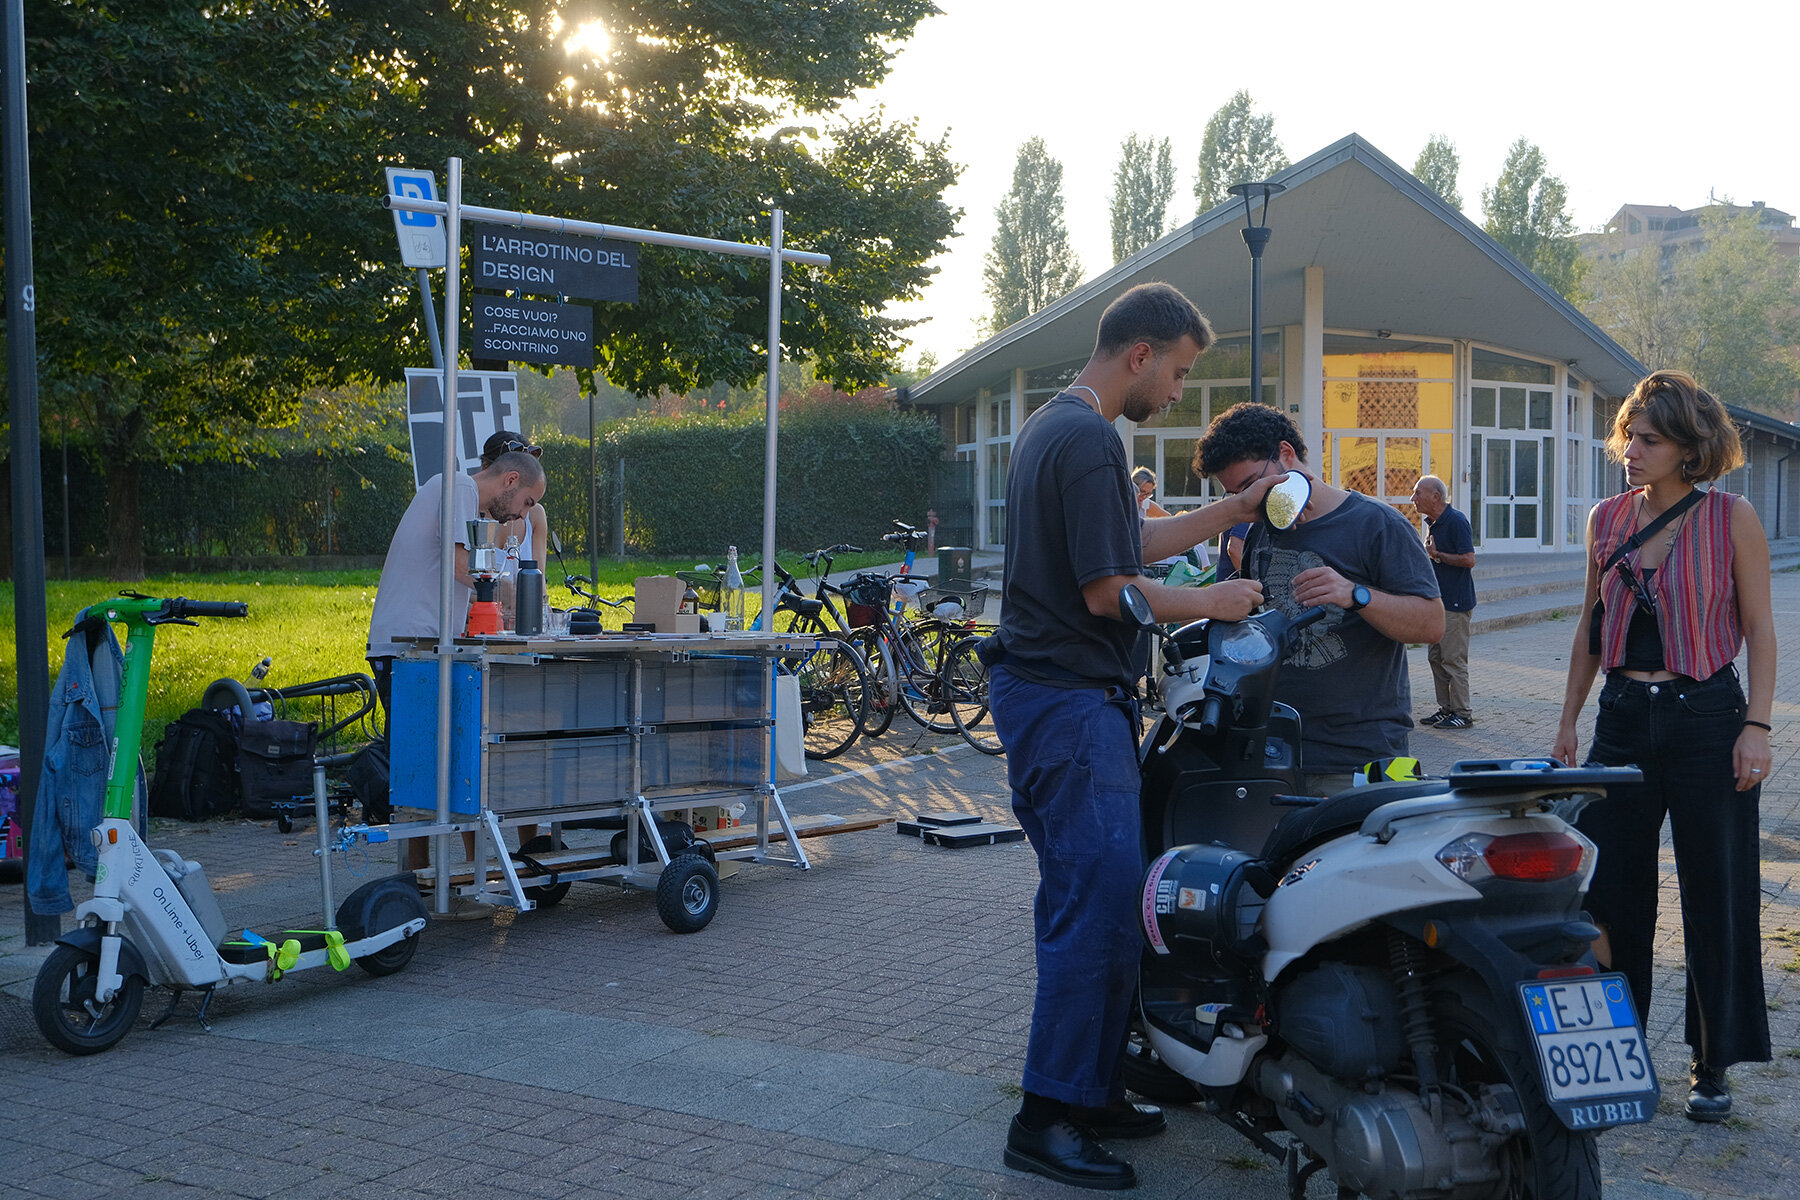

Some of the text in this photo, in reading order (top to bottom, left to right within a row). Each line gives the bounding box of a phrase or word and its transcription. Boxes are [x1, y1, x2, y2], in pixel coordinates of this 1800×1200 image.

[482, 235, 631, 268] L'ARROTINO DEL
[482, 261, 555, 283] DESIGN
[484, 306, 558, 323] COSE VUOI?
[484, 323, 587, 342] ...FACCIAMO UNO
[484, 339, 559, 355] SCONTRINO
[153, 887, 167, 905] On
[163, 902, 183, 929] Lime
[185, 934, 205, 960] Uber
[1550, 985, 1594, 1028] EJ
[1548, 1038, 1646, 1088] 89213
[1570, 1101, 1644, 1127] RUBEI
